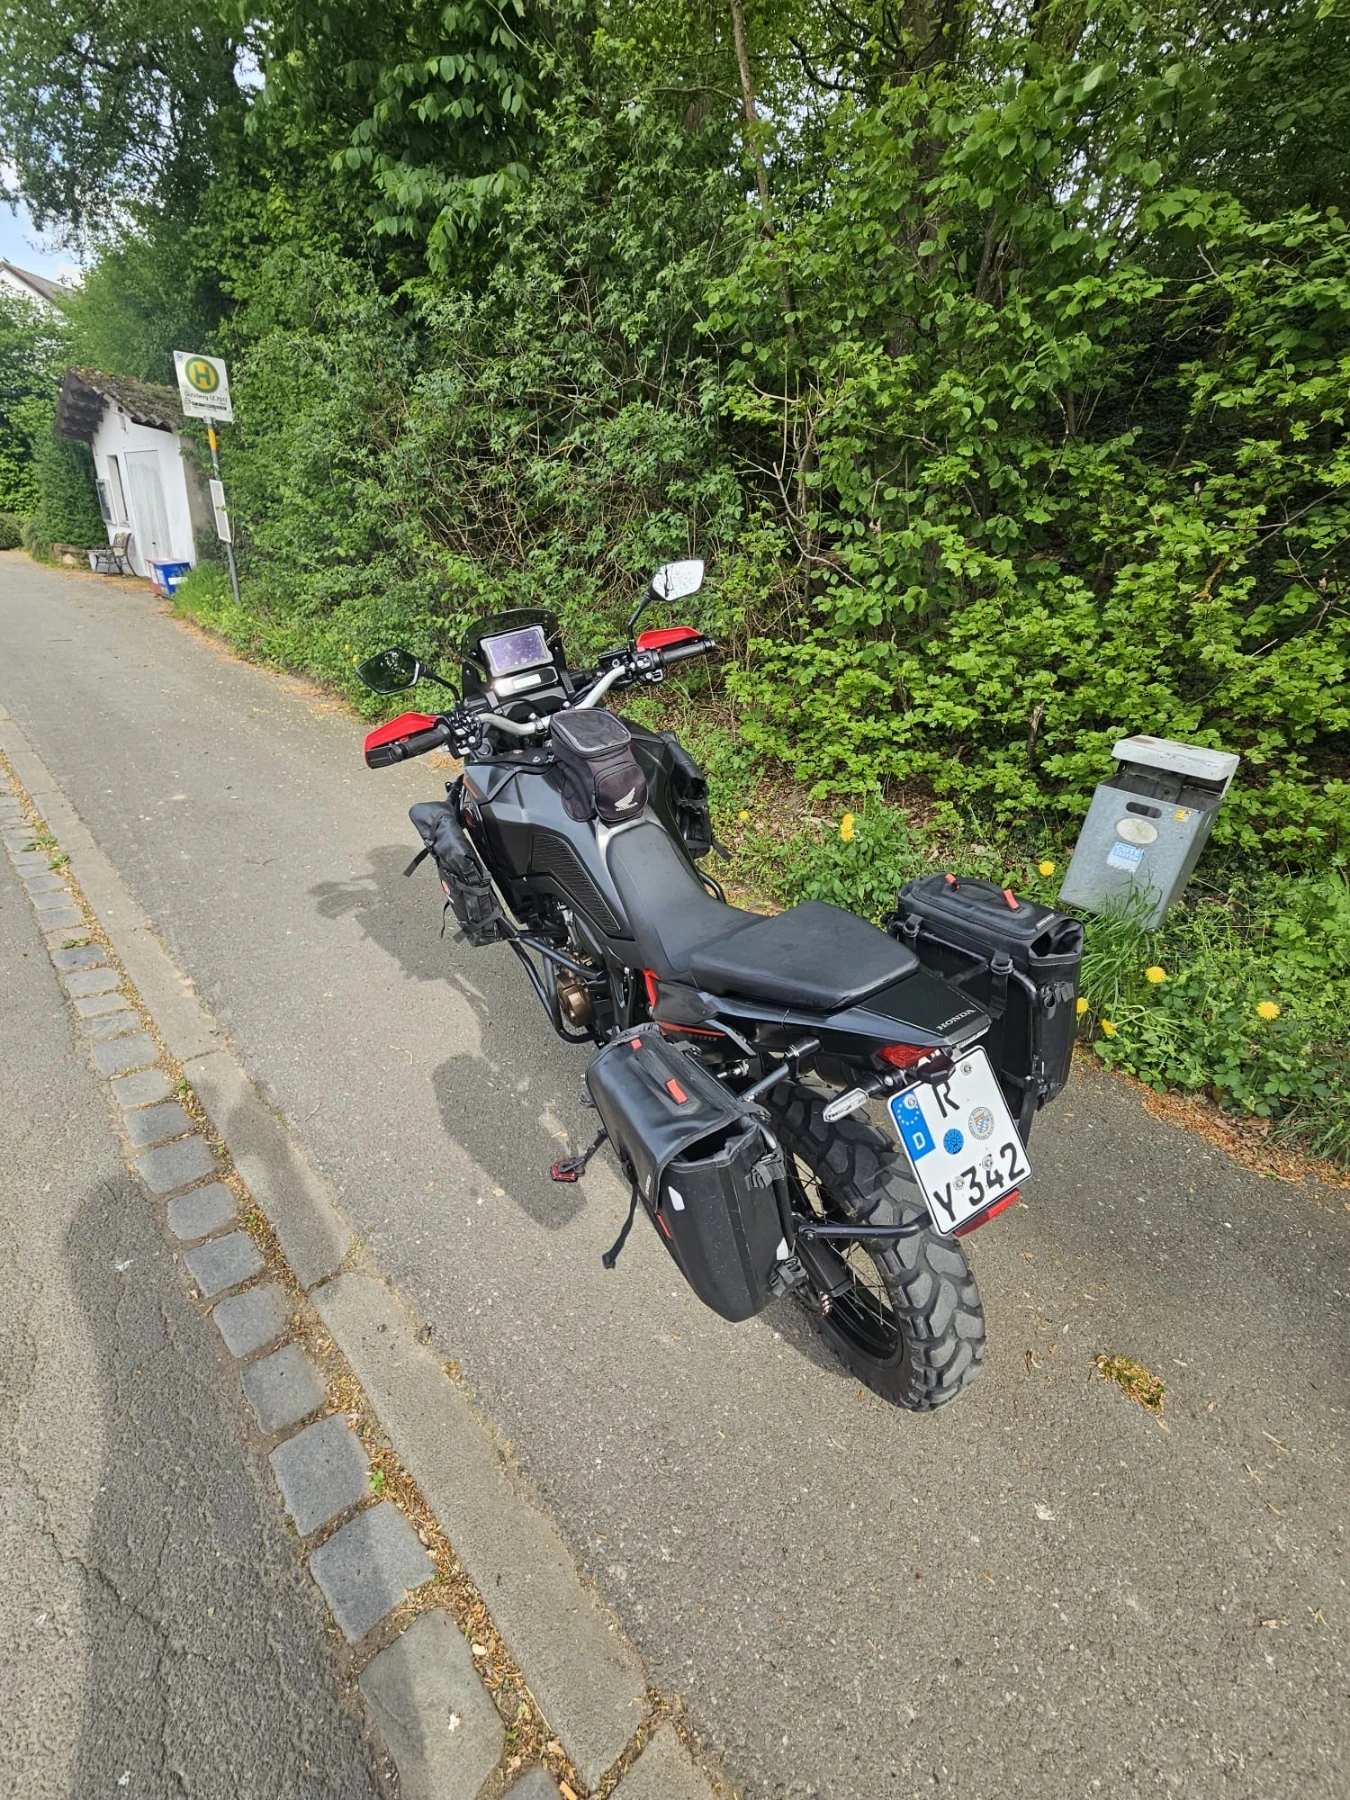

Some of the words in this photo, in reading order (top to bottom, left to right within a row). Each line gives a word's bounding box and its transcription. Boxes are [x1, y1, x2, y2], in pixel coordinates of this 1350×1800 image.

[193, 364, 212, 386] H
[936, 1009, 976, 1031] HONDA
[932, 1080, 960, 1118] R
[912, 1131, 926, 1150] D
[961, 1142, 1025, 1207] 342
